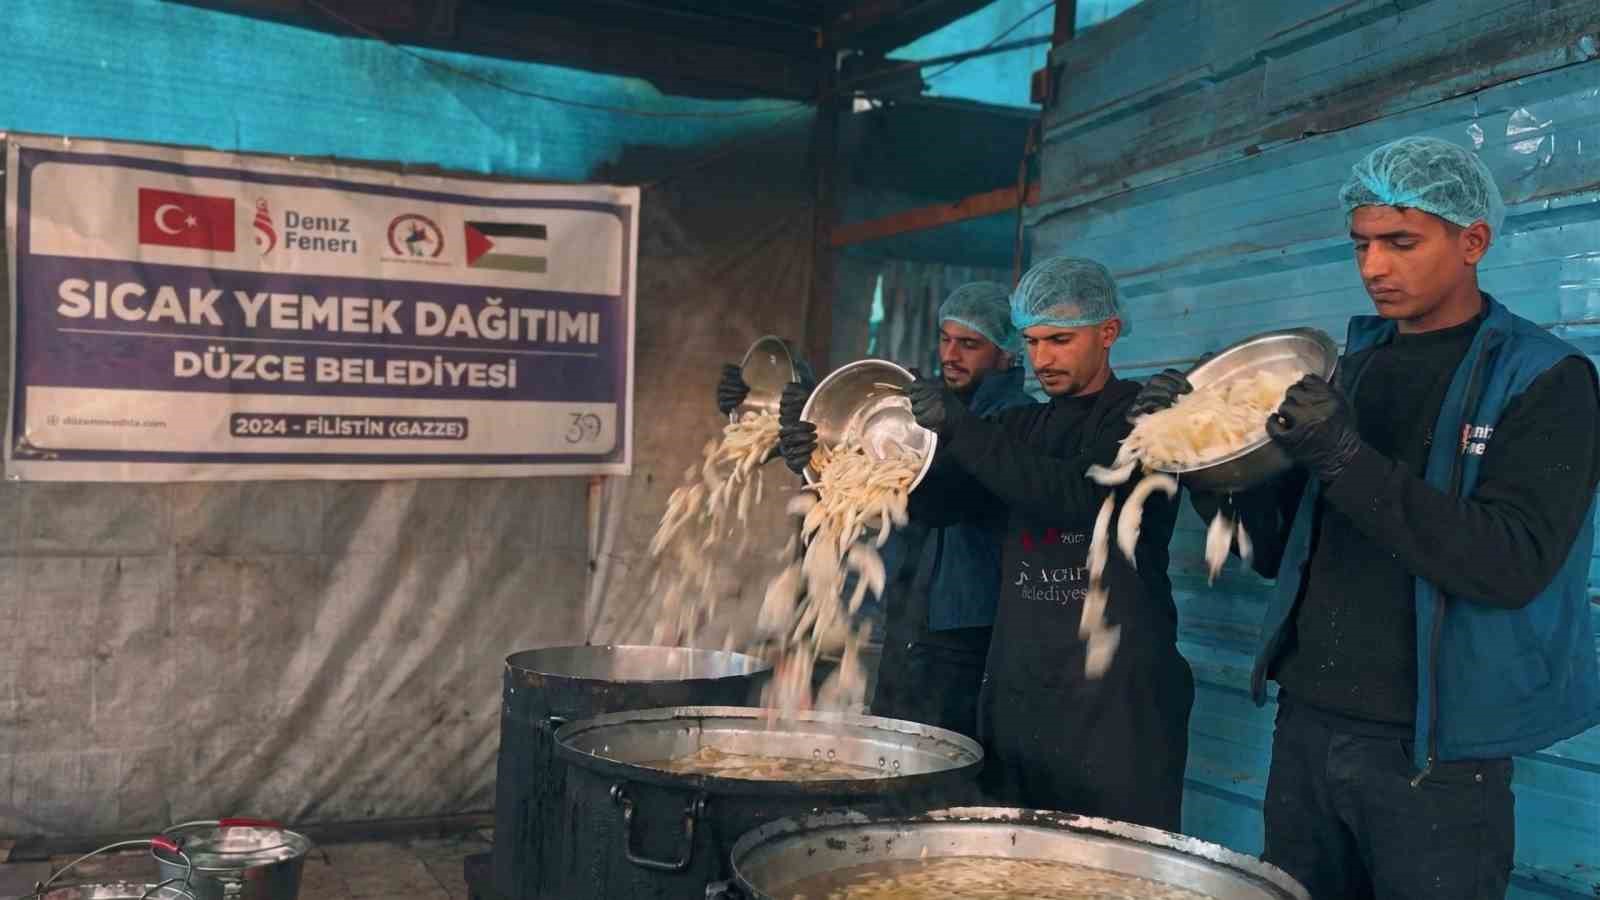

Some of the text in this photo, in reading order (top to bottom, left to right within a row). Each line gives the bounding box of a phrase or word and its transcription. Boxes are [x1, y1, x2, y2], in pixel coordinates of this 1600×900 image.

[57, 278, 600, 344] SICAK YEMEK DAĞITIMI
[174, 346, 517, 388] DÜZCE BELEDİYESİ
[235, 417, 286, 434] 2024
[305, 416, 385, 436] FİLİSTİN
[388, 421, 464, 438] (GAZZE)
